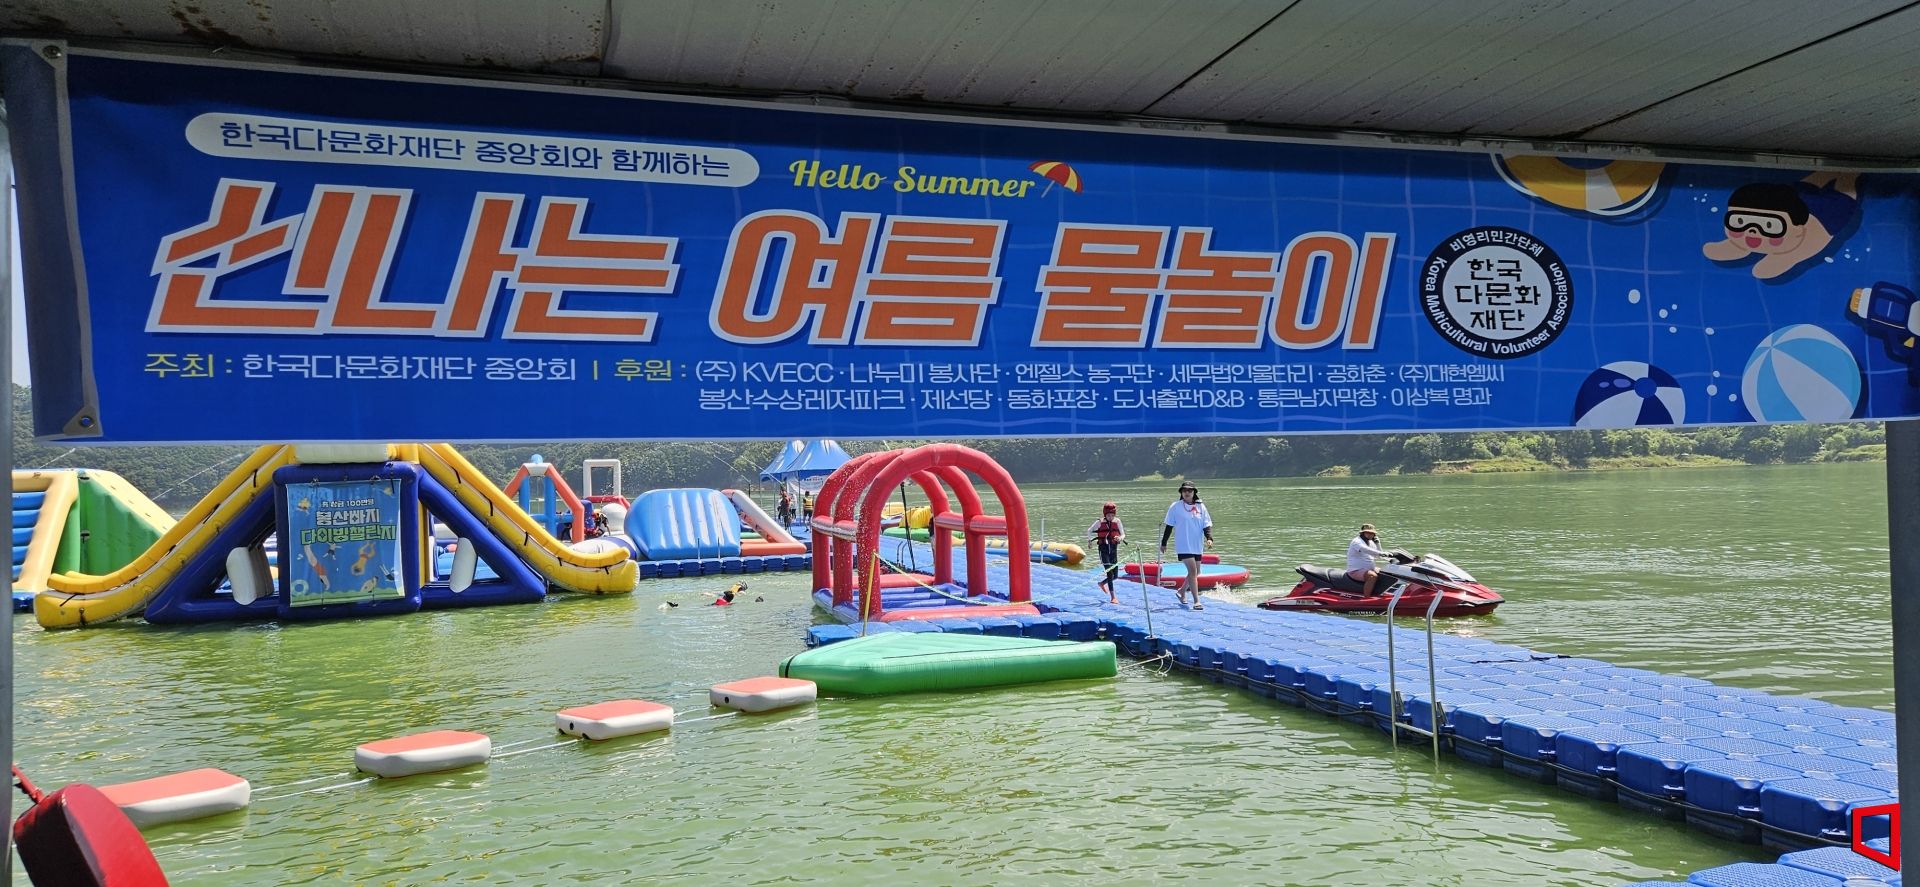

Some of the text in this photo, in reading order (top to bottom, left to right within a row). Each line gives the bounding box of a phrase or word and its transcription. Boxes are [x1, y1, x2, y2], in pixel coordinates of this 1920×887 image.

[220, 121, 730, 177] 한국다문화재단 중앙회와 함께하는
[789, 160, 1035, 198] Hello Summer
[1450, 230, 1544, 257] 비영리민간단체
[145, 177, 1397, 349] 신나는 여름 물놀이
[1467, 259, 1522, 282] 한국
[1425, 256, 1568, 354] Korea Multicultural Volunteer Association
[1454, 283, 1541, 305] 다문화
[1470, 309, 1525, 330] 재단
[144, 353, 576, 381] 주최 한국다문화재단 중앙회
[613, 359, 673, 381] 후원
[695, 360, 736, 383] (주)
[743, 362, 834, 384] KVECC
[850, 362, 924, 384] 나누미
[928, 363, 998, 384] 봉사단
[1016, 363, 1083, 383] 엔젤스
[1087, 364, 1155, 383] 농구단
[1170, 364, 1314, 384] 세무법인울타리
[1326, 364, 1386, 383] 공화춘
[698, 388, 1492, 411] 봉산수상레저파크 제선당 동화포장 도서출판D&B 통큰남자막창 이상복 명과
[301, 525, 397, 545] 다이빙챌린지
